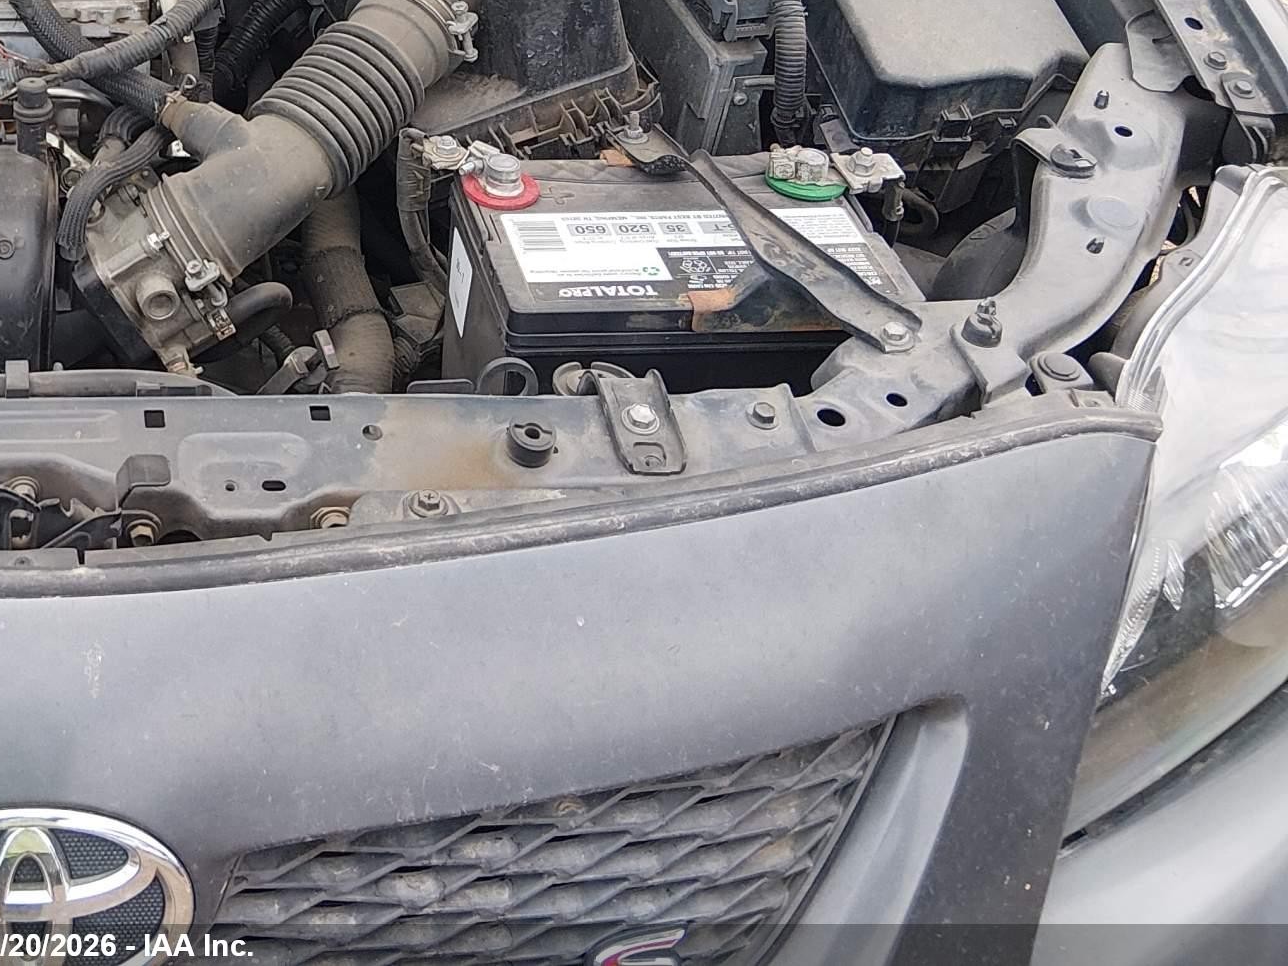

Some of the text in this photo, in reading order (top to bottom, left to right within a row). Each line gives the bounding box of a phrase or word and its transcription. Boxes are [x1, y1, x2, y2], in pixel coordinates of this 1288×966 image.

[575, 225, 606, 235] 650
[618, 224, 650, 234] 520
[666, 224, 685, 233] 35
[559, 284, 659, 298] TOTALPRO
